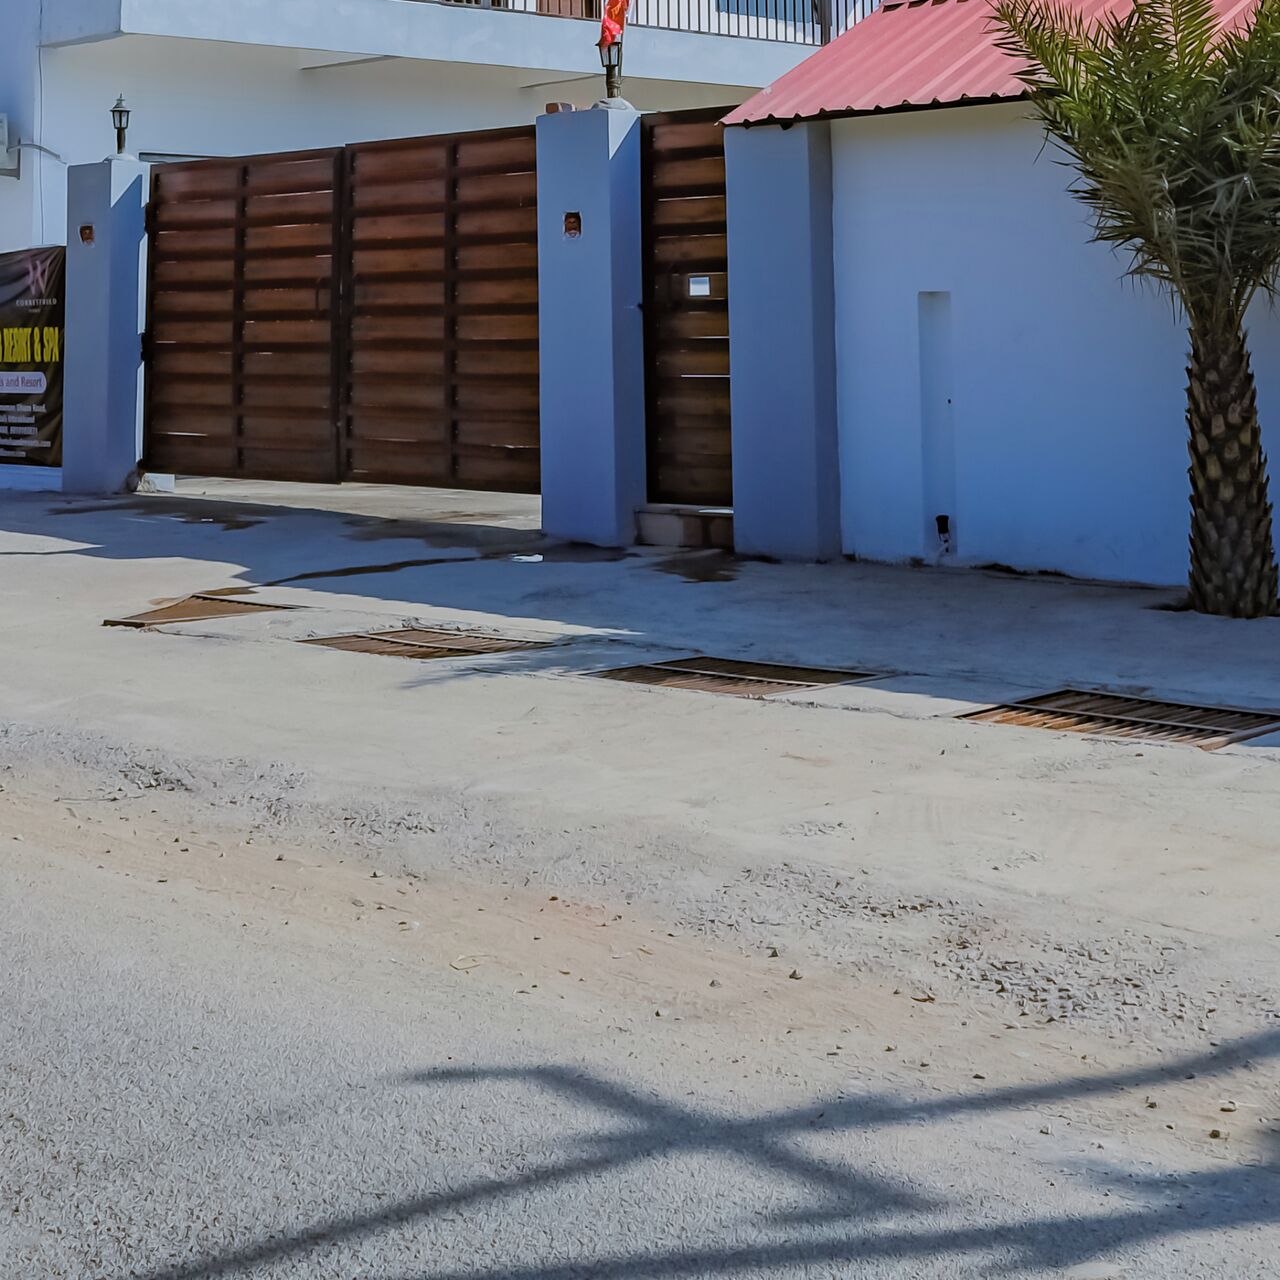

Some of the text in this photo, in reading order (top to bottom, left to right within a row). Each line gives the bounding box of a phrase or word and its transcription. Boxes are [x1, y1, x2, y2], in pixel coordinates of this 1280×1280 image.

[34, 326, 42, 362] &
[43, 326, 59, 362] SPA
[5, 376, 19, 387] and
[20, 376, 43, 388] Resort
